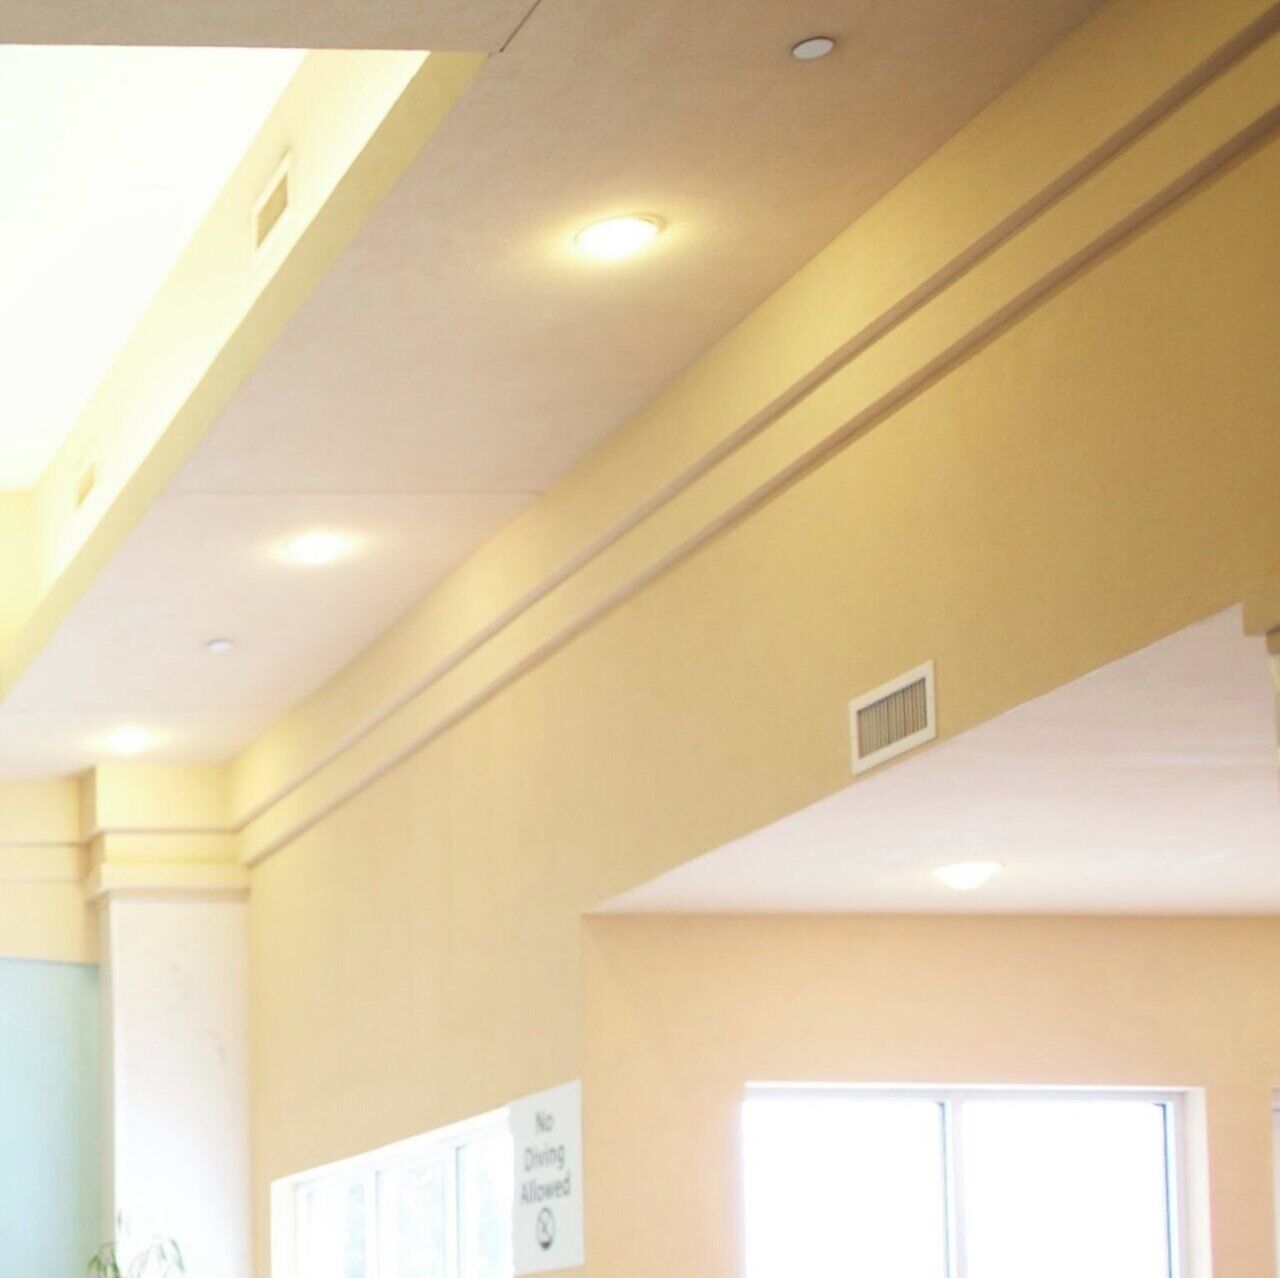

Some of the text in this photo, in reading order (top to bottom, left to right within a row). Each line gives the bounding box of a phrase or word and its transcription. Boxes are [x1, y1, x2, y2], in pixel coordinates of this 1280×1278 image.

[535, 1110, 553, 1133] No
[524, 1143, 565, 1171] Diving
[522, 1170, 571, 1204] Allowed
